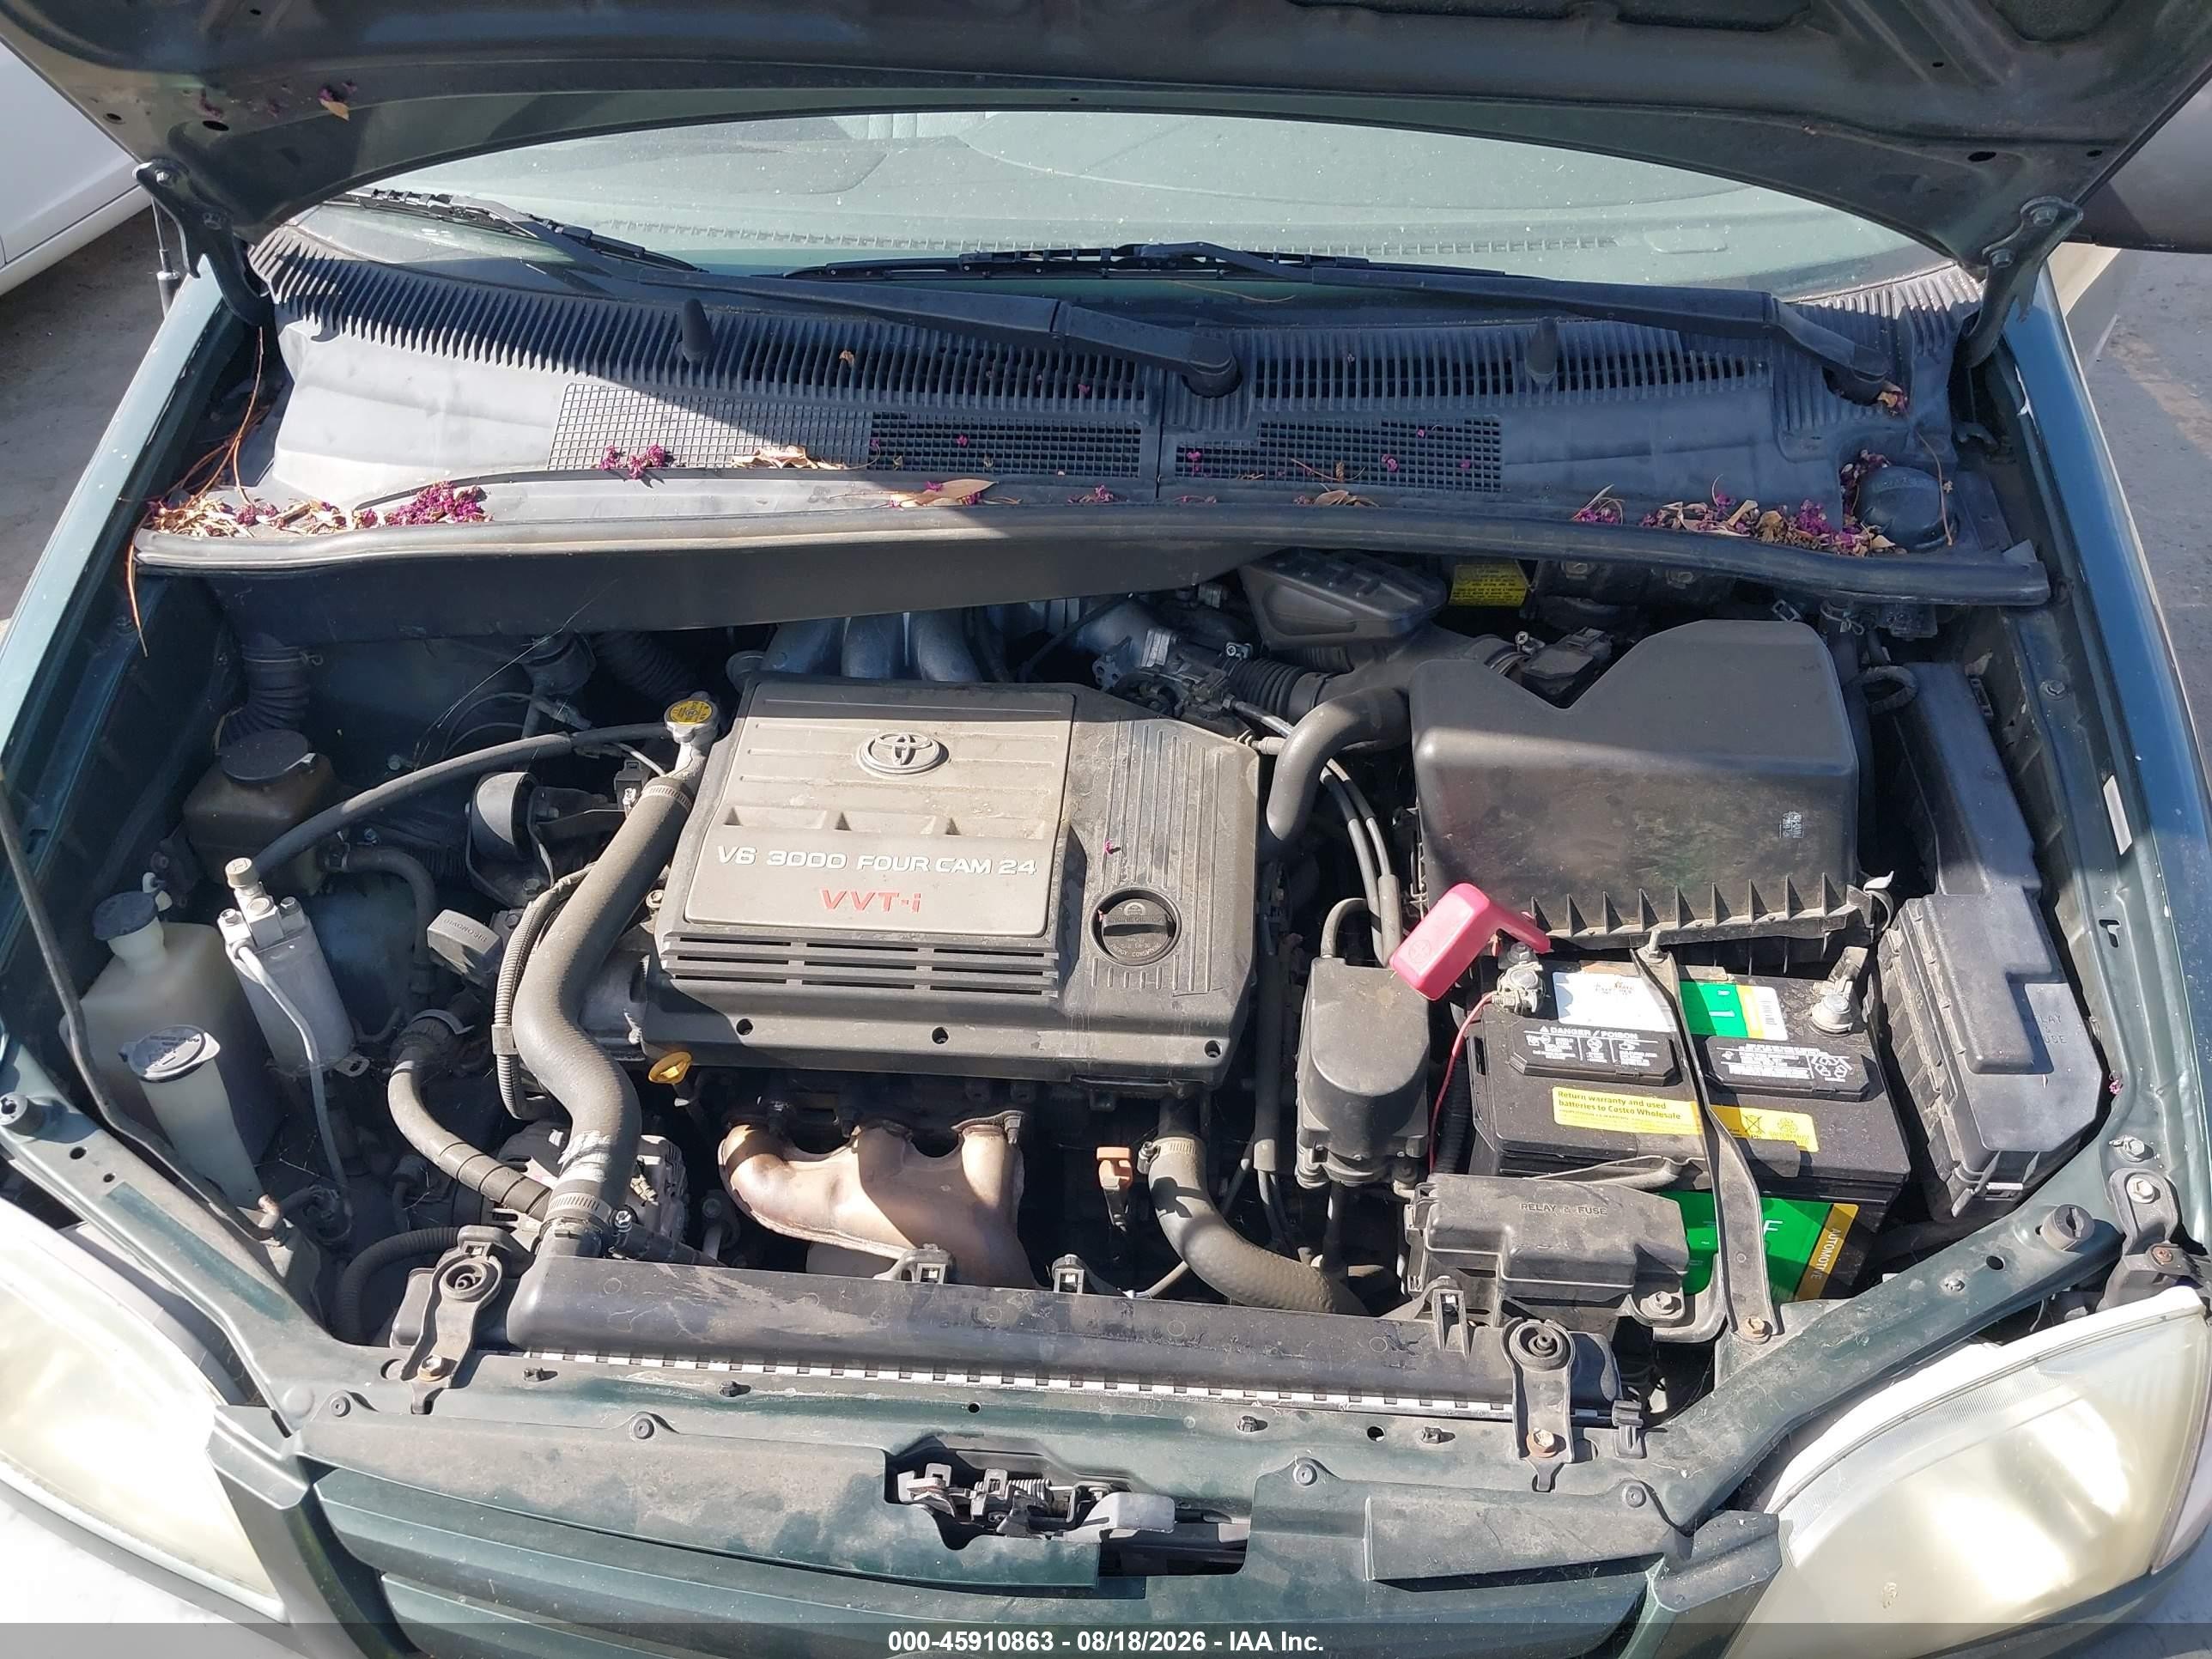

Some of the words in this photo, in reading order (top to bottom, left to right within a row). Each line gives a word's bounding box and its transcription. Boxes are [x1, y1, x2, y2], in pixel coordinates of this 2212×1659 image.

[717, 845, 757, 865] V6
[767, 850, 848, 869] 3000
[856, 854, 930, 872] FOUR
[935, 857, 992, 874] CAM
[998, 859, 1038, 875] 24
[1550, 1027, 1591, 1036] DANGER
[1601, 1030, 1638, 1040] POISON
[1558, 1091, 1587, 1100] Return
[1588, 1095, 1626, 1106] warranty
[1628, 1098, 1644, 1107] and
[1646, 1101, 1667, 1109] used
[1559, 1100, 1596, 1110] batteries
[1607, 1105, 1635, 1115] Costco
[1636, 1109, 1681, 1120] Wholesale
[1520, 1203, 1556, 1212] RELAY
[1577, 1206, 1607, 1215] FUSE
[1810, 1228, 1842, 1279] AUTOMOTIVE
